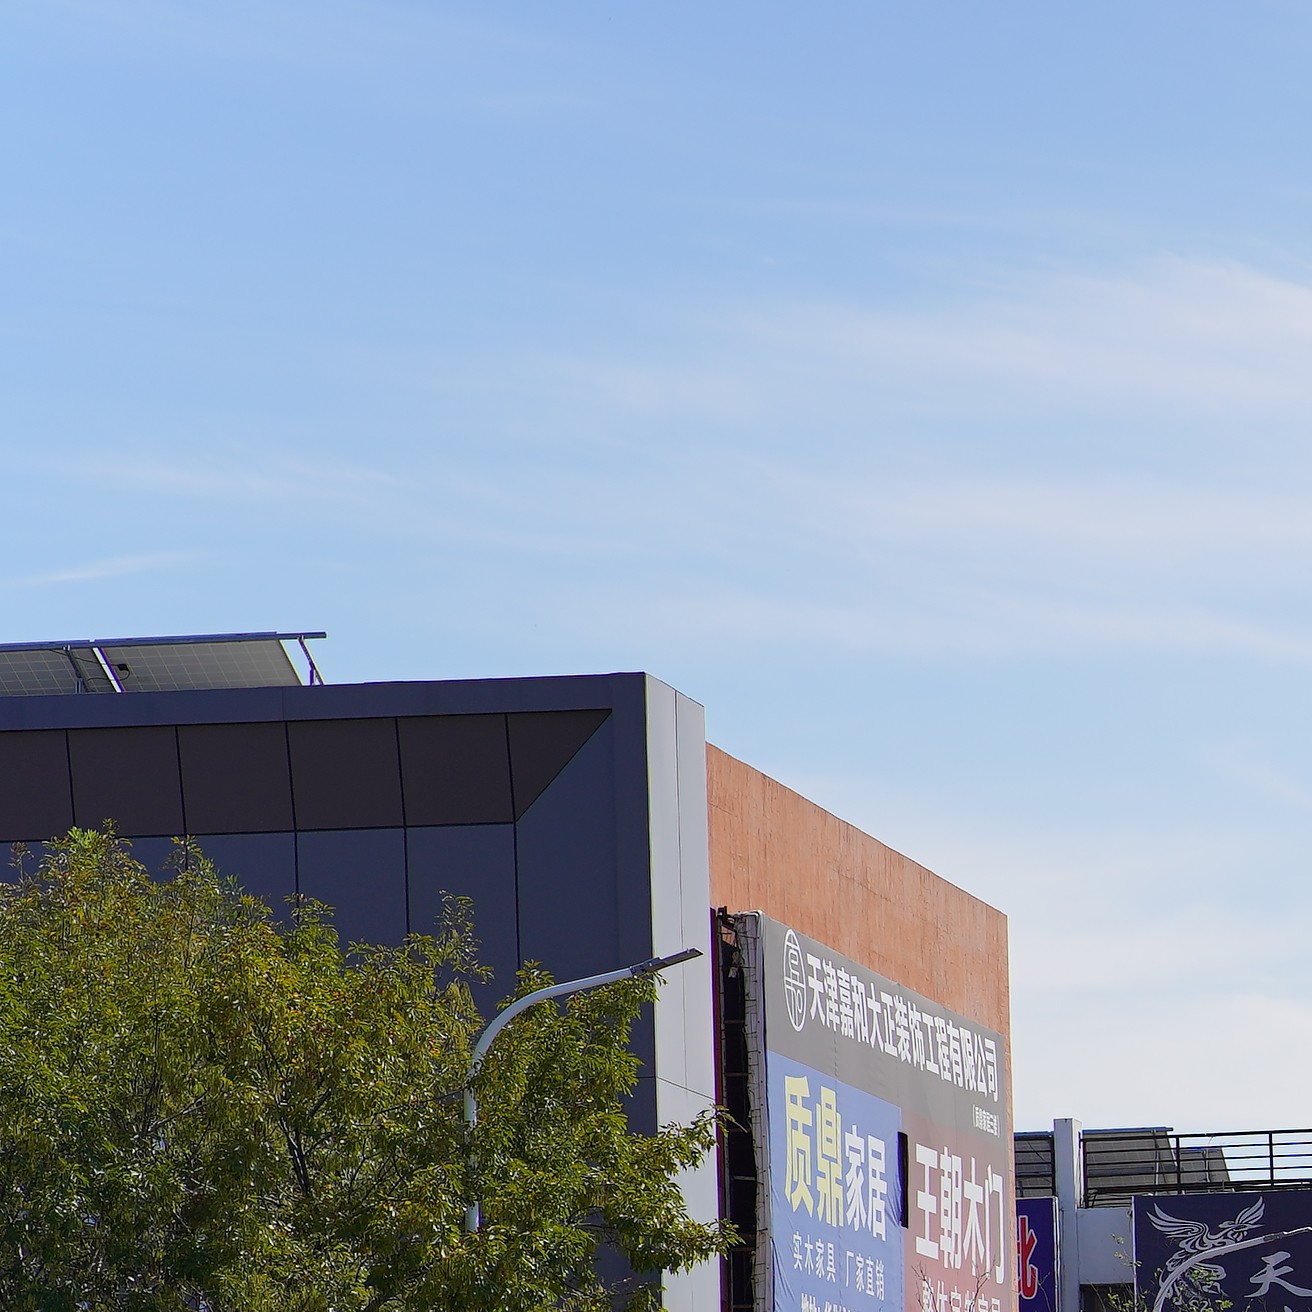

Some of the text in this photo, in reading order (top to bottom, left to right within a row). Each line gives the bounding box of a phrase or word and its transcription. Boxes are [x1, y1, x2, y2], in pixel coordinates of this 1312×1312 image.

[784, 1076, 888, 1241] 质鼎家居
[915, 1143, 1005, 1285] 王朝木门
[793, 1232, 886, 1301] 实木家具 厂家直销
